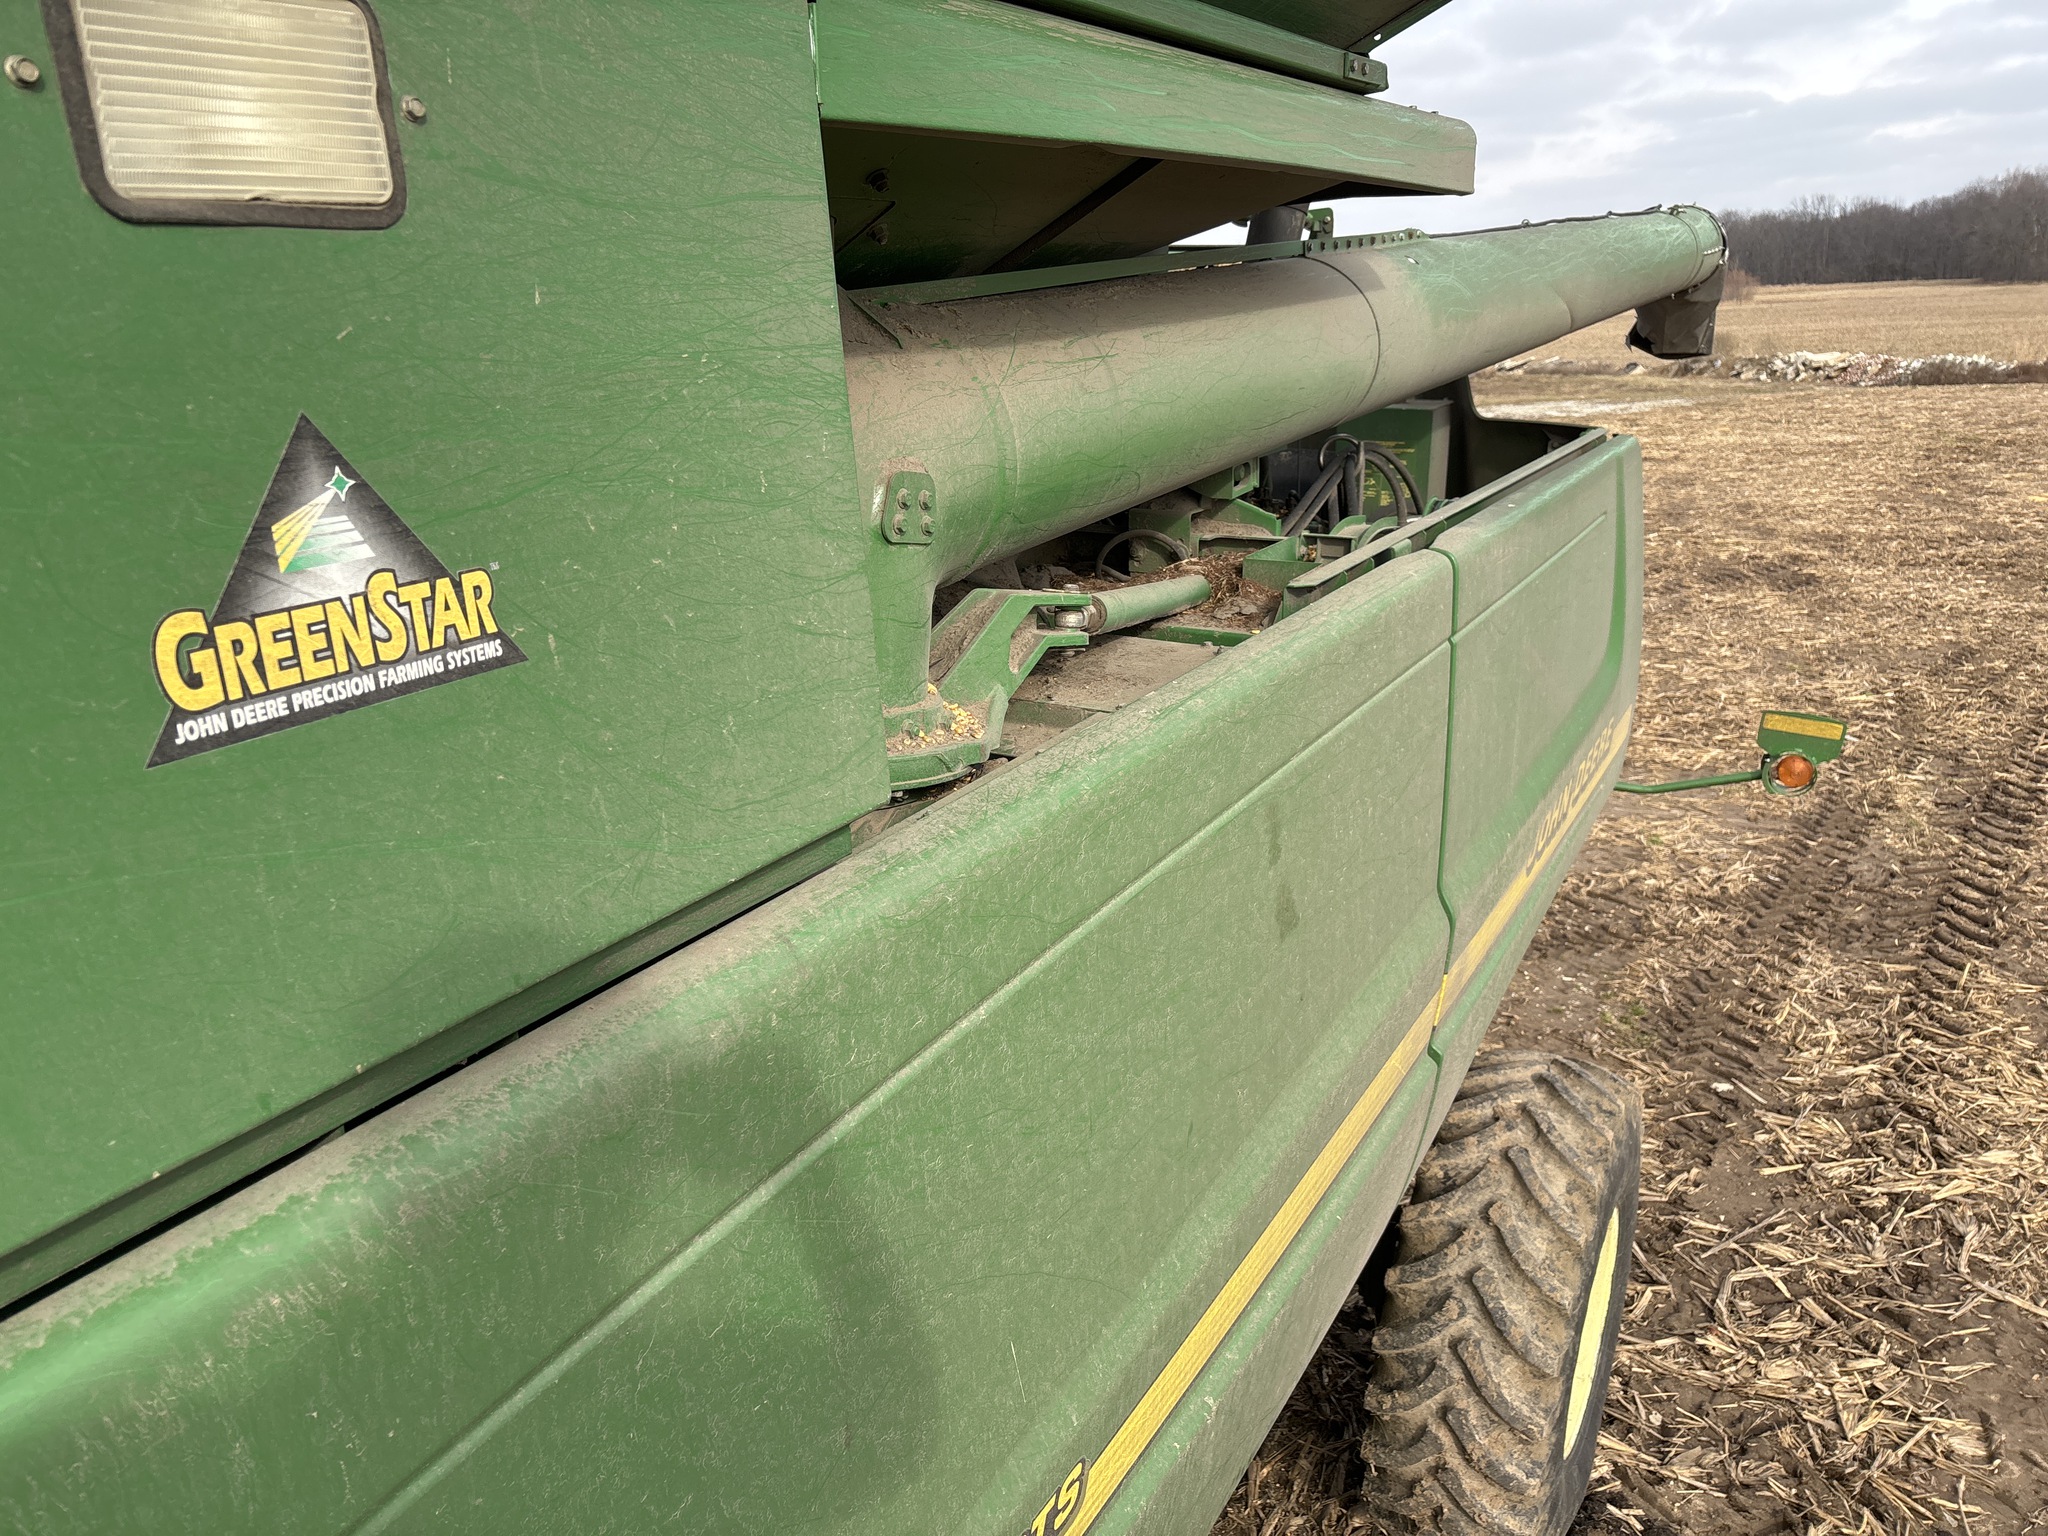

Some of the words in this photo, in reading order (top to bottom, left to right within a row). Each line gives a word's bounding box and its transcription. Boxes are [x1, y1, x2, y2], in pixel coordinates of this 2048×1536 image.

[174, 712, 229, 746] JOHN
[230, 695, 290, 730] DEERE
[291, 672, 376, 713] PRECISION
[377, 654, 445, 689] FARMING
[446, 638, 504, 670] SYSTEMS
[1526, 778, 1573, 868] JOHN
[1023, 1461, 1083, 1536] TS
